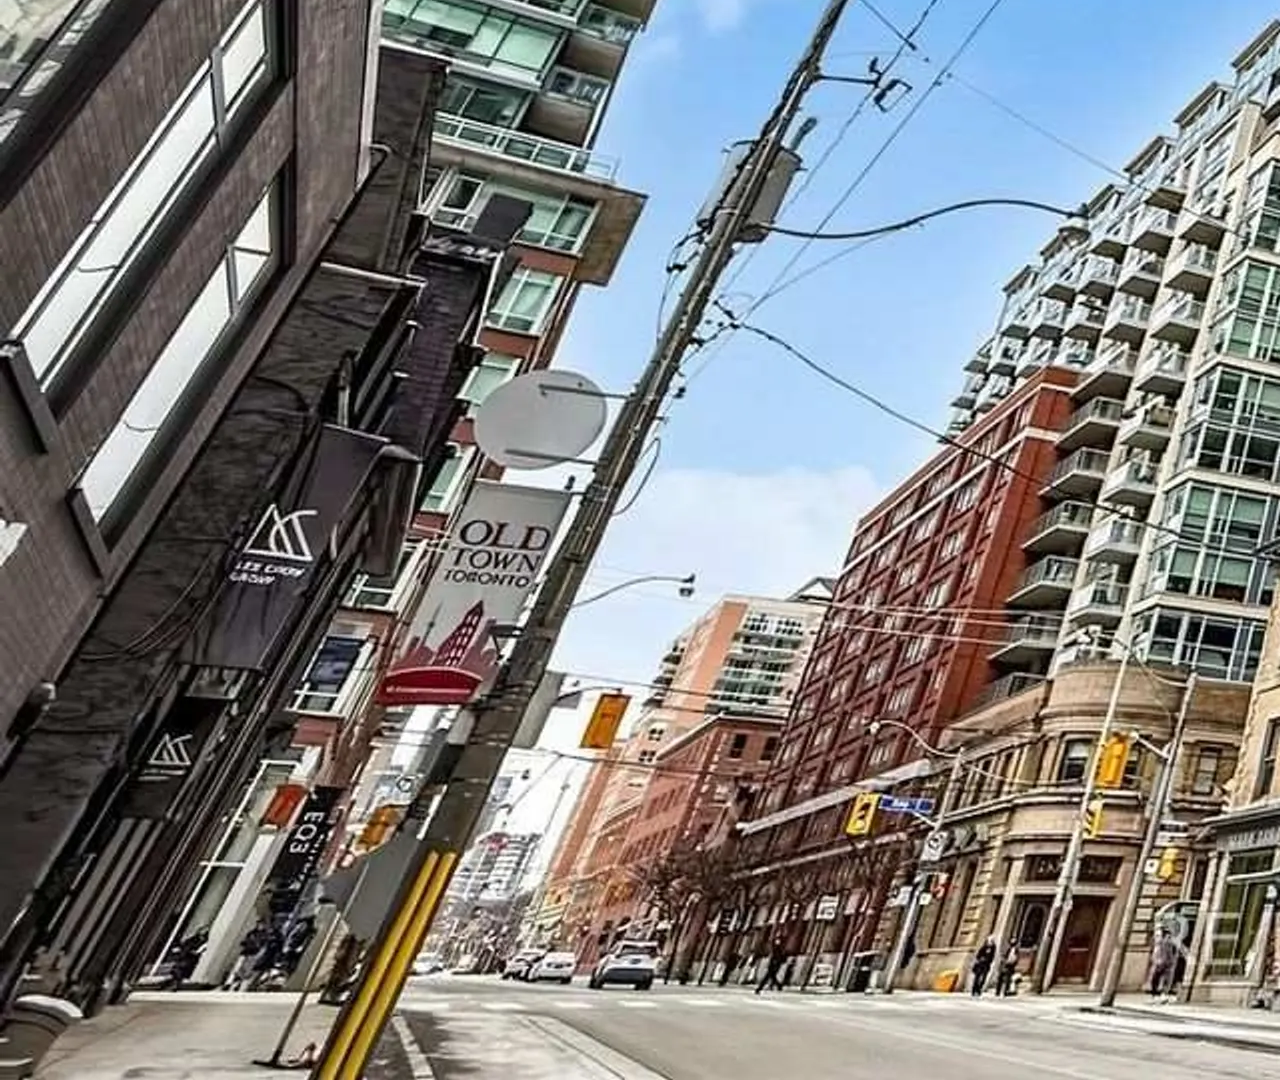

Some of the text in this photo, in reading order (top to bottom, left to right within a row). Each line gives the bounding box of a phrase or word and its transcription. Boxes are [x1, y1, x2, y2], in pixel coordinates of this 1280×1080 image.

[460, 519, 551, 551] OLD
[452, 547, 541, 572] TOWN
[444, 569, 530, 588] TORONTO
